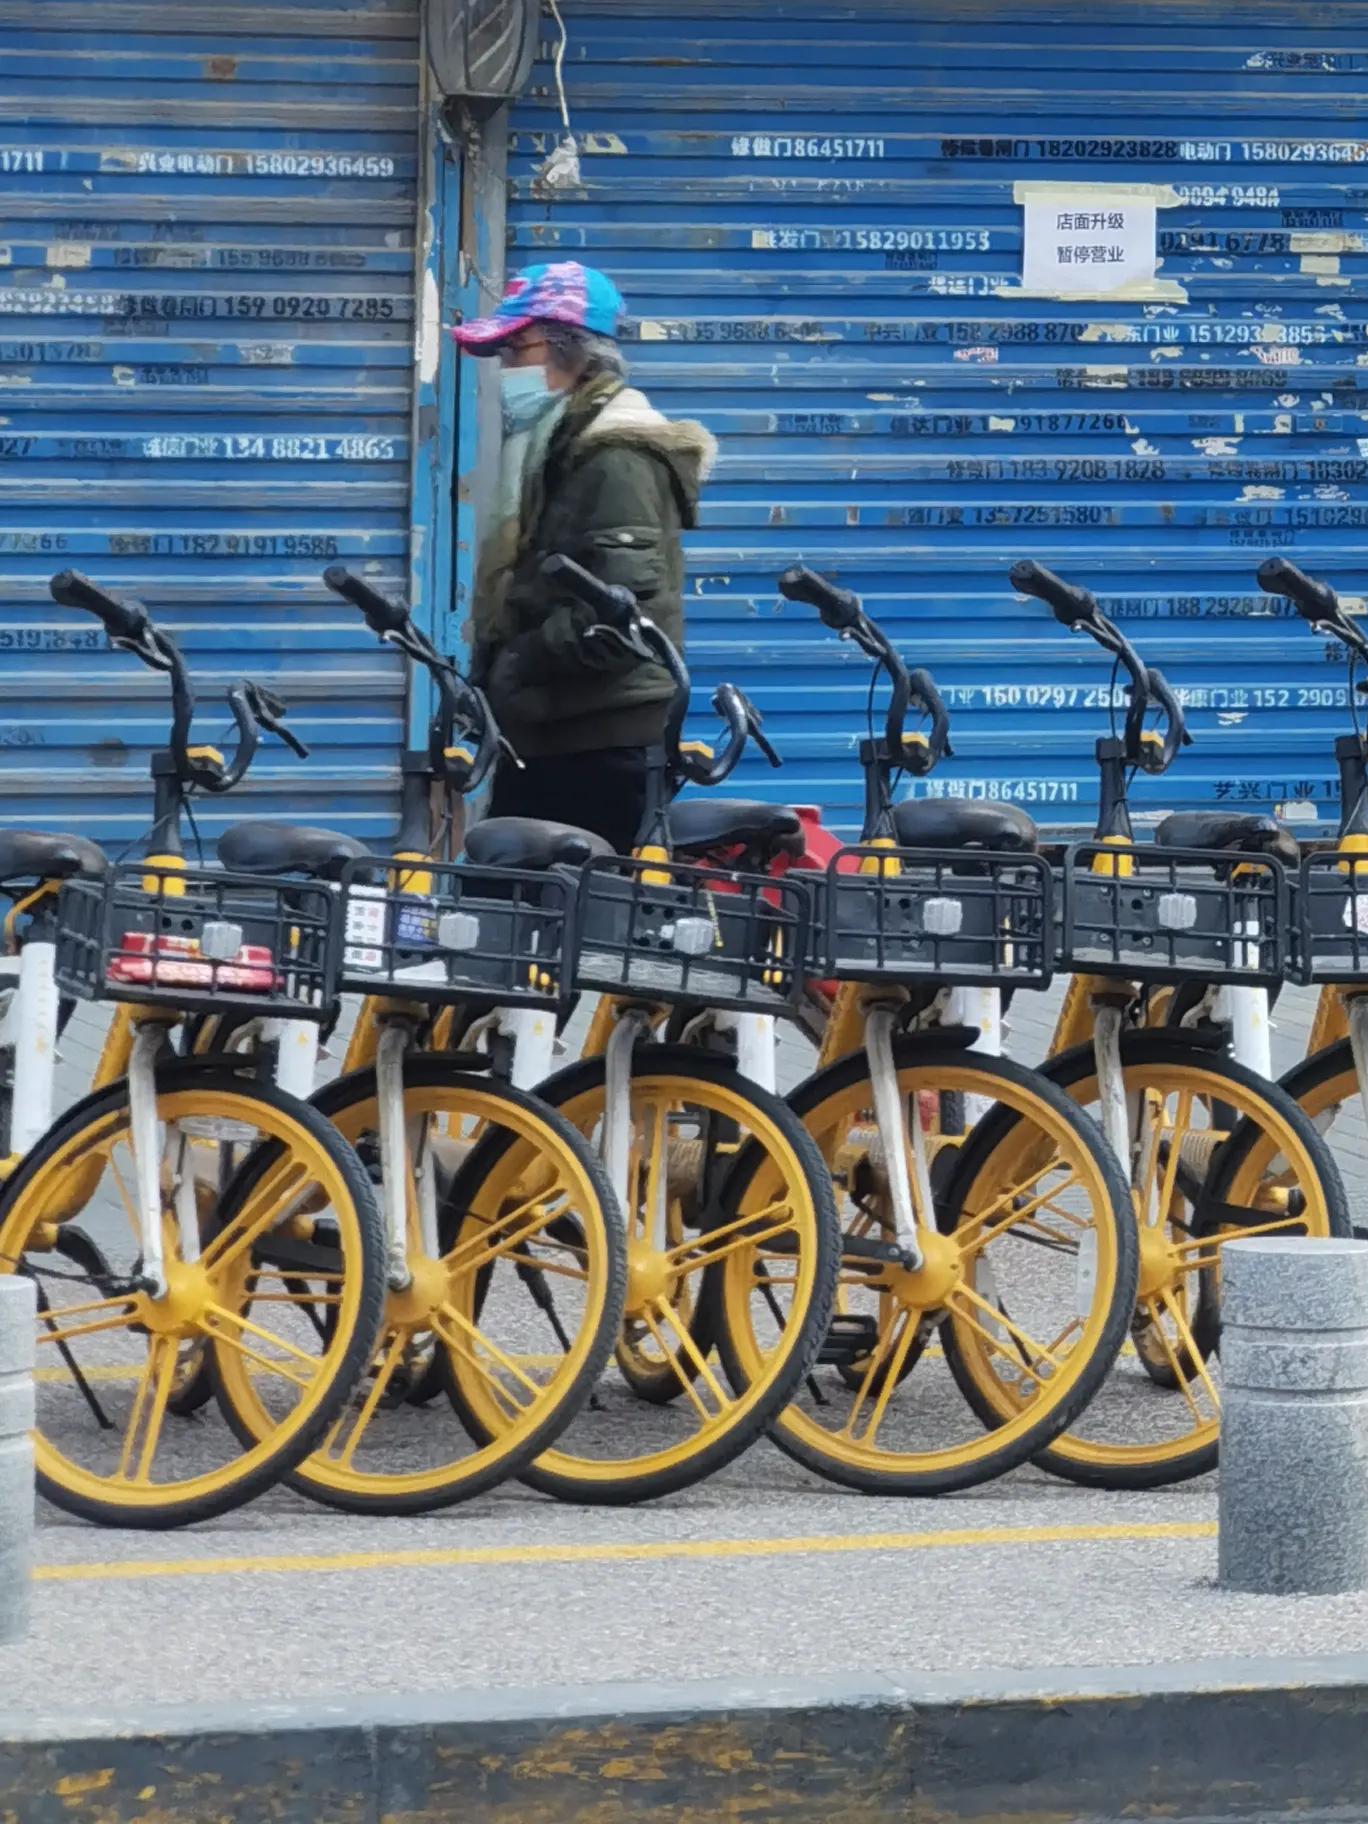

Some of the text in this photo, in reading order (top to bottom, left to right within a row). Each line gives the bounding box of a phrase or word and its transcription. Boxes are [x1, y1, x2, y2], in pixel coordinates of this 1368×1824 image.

[246, 154, 395, 177] 15802936459
[1056, 212, 1125, 232] 店面升级
[1056, 245, 1125, 265] 暂停营业
[225, 296, 265, 318] 159
[272, 297, 331, 318] 0920
[338, 297, 395, 319] 7285
[1254, 689, 1289, 707] 152
